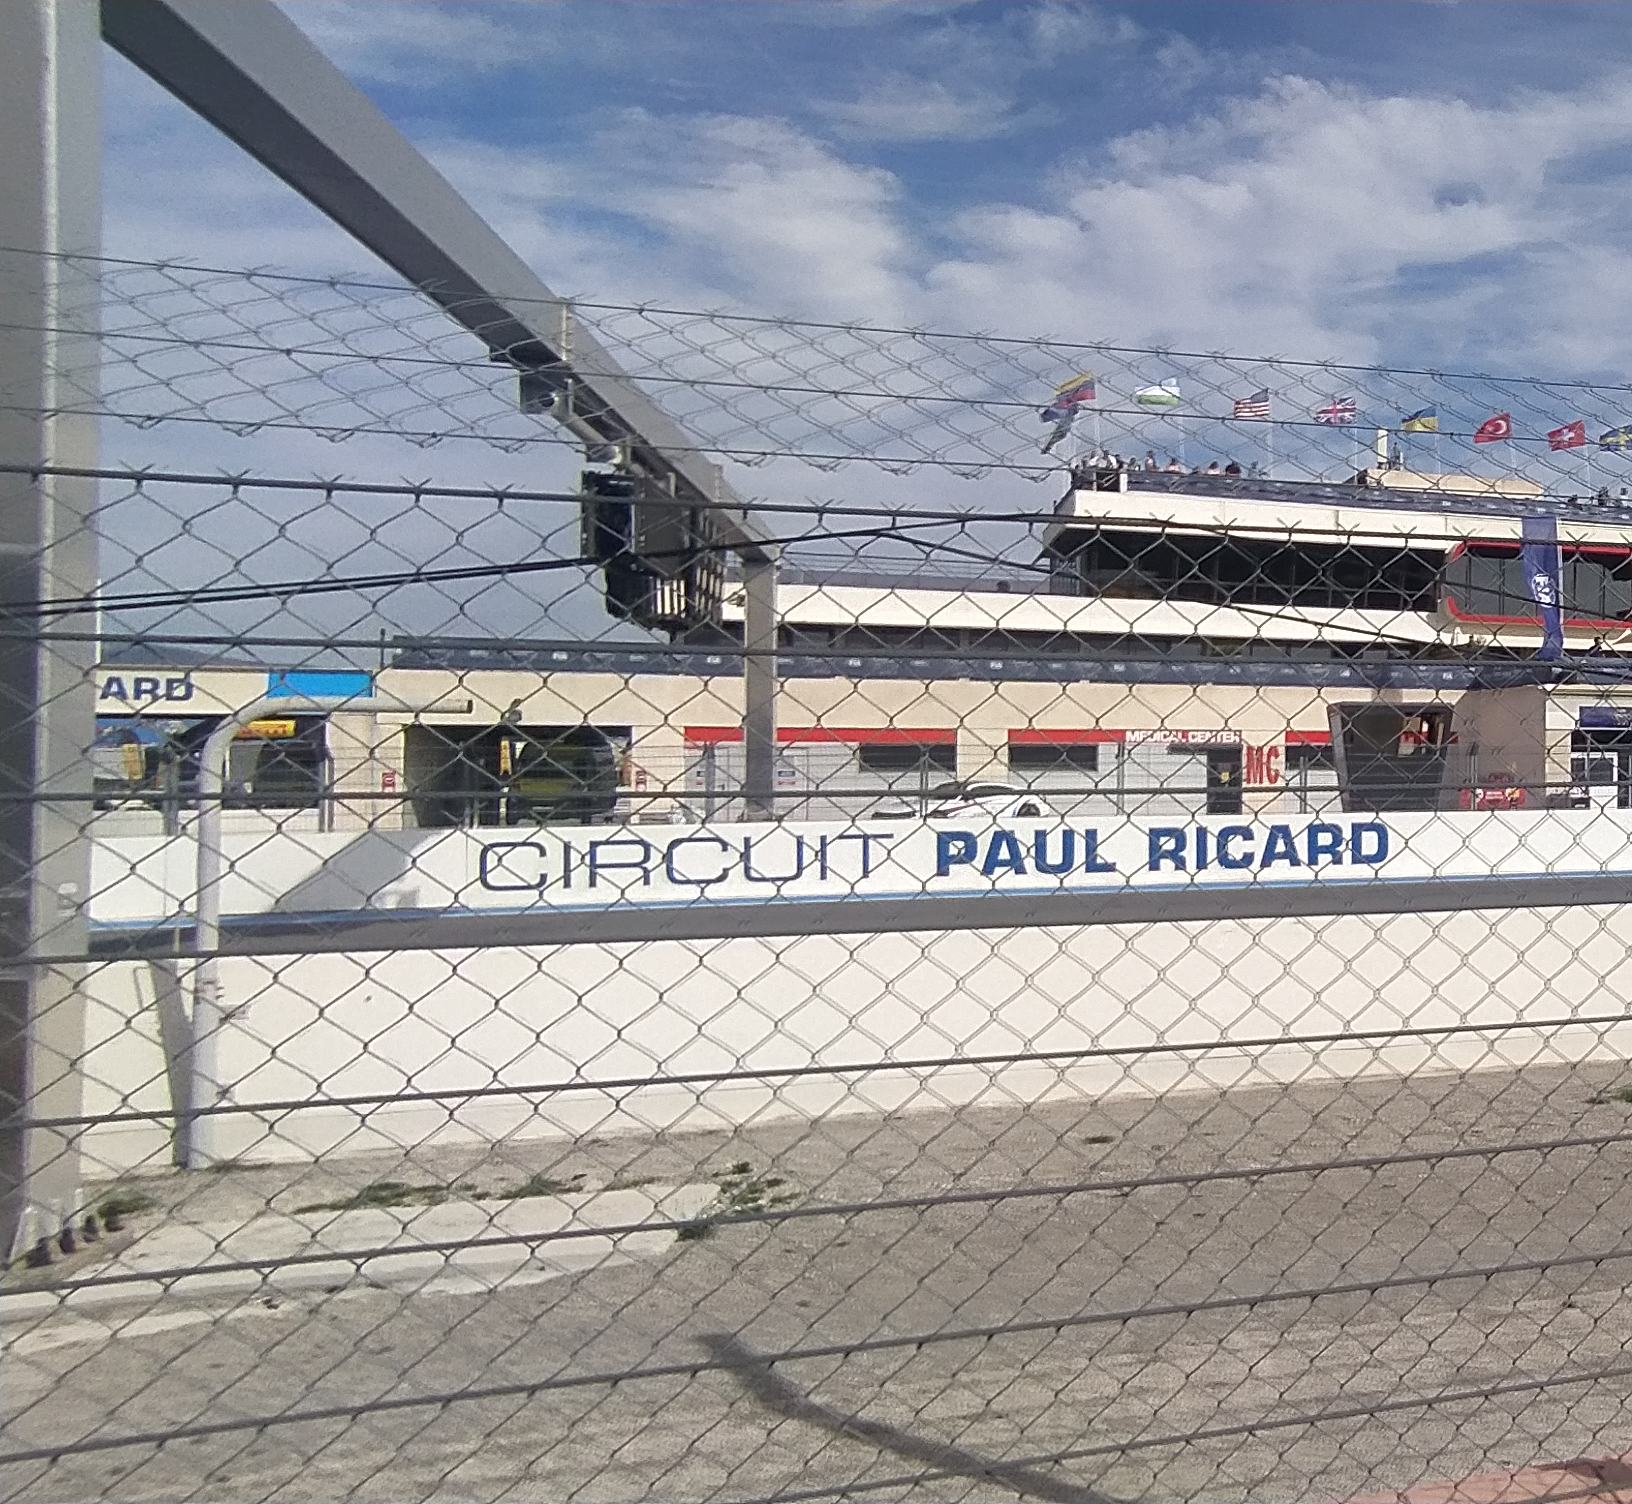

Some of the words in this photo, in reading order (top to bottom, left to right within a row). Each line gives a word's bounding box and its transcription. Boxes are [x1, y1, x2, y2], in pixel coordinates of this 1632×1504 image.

[1126, 730, 1187, 743] MEDICAL
[1188, 731, 1241, 743] CENTER
[1246, 745, 1280, 784] MC
[480, 833, 894, 891] CIRCUIT
[936, 828, 1117, 877] PAUL
[1148, 822, 1389, 872] RICARD
